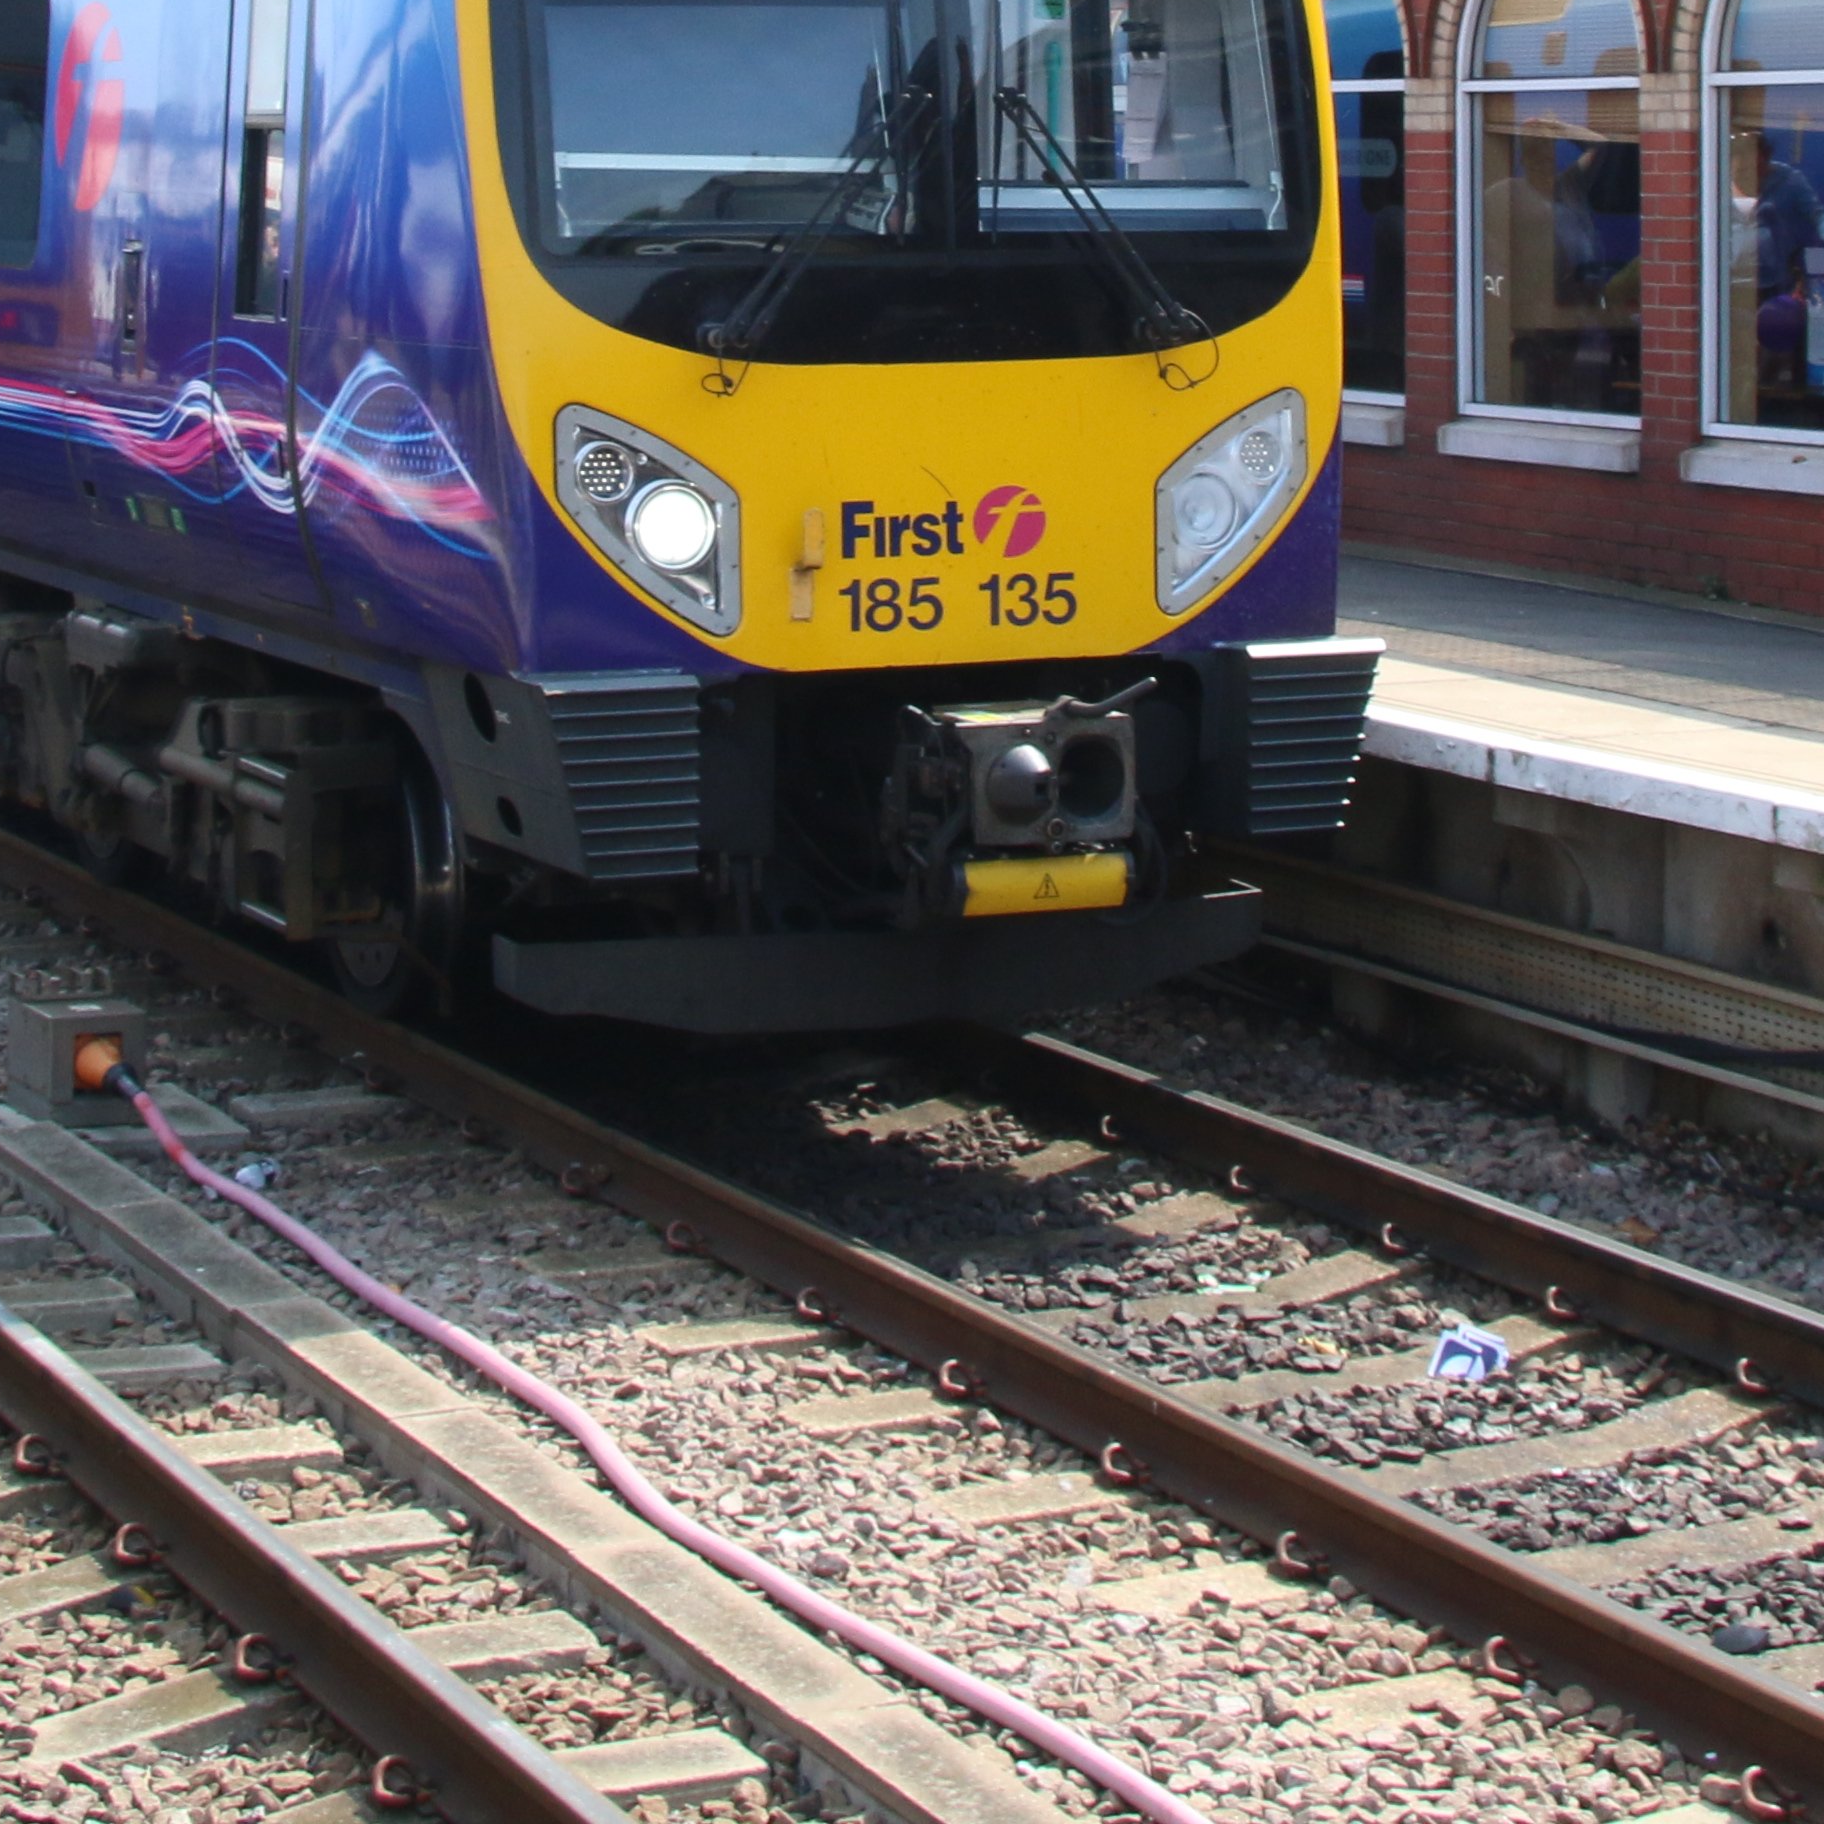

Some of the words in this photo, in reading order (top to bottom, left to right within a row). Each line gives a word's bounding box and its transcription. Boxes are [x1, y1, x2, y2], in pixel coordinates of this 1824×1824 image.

[840, 500, 965, 559] First
[838, 576, 944, 632] 185
[979, 571, 1078, 627] 135
